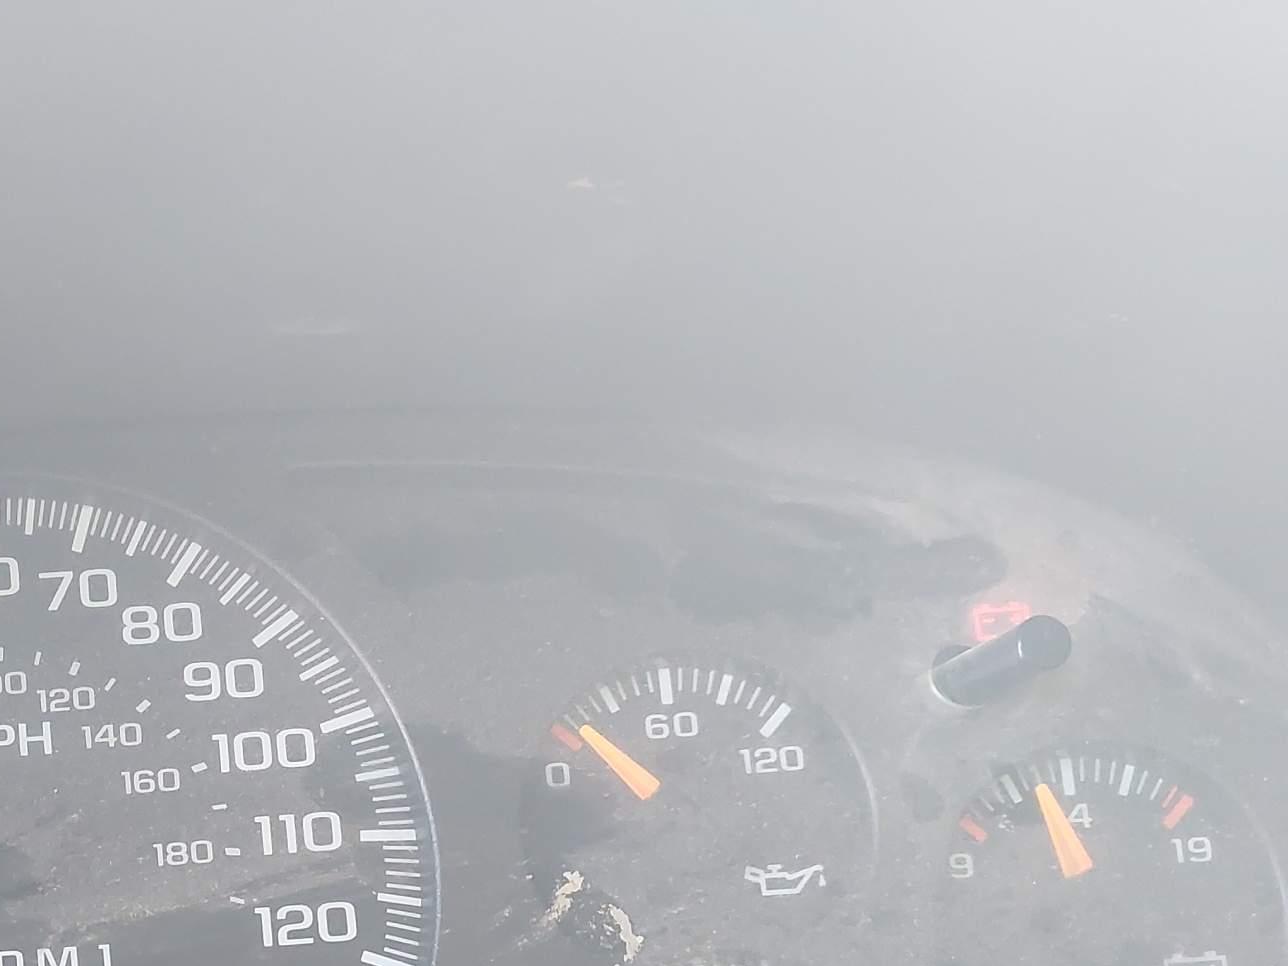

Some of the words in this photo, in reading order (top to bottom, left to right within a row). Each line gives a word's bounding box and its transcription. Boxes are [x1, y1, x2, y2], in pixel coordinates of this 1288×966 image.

[39, 568, 118, 611] 70
[121, 602, 203, 645] 80
[183, 658, 264, 701] 90
[37, 686, 96, 712] 120
[81, 723, 142, 748] 140
[645, 712, 699, 739] 60
[212, 728, 316, 773] 100
[739, 745, 804, 774] 120
[121, 768, 180, 794] 160
[545, 762, 570, 787] 0
[254, 811, 342, 856] 110
[152, 840, 214, 867] 180
[1170, 836, 1213, 863] 19
[949, 853, 974, 879] 9
[254, 901, 357, 947] 120
